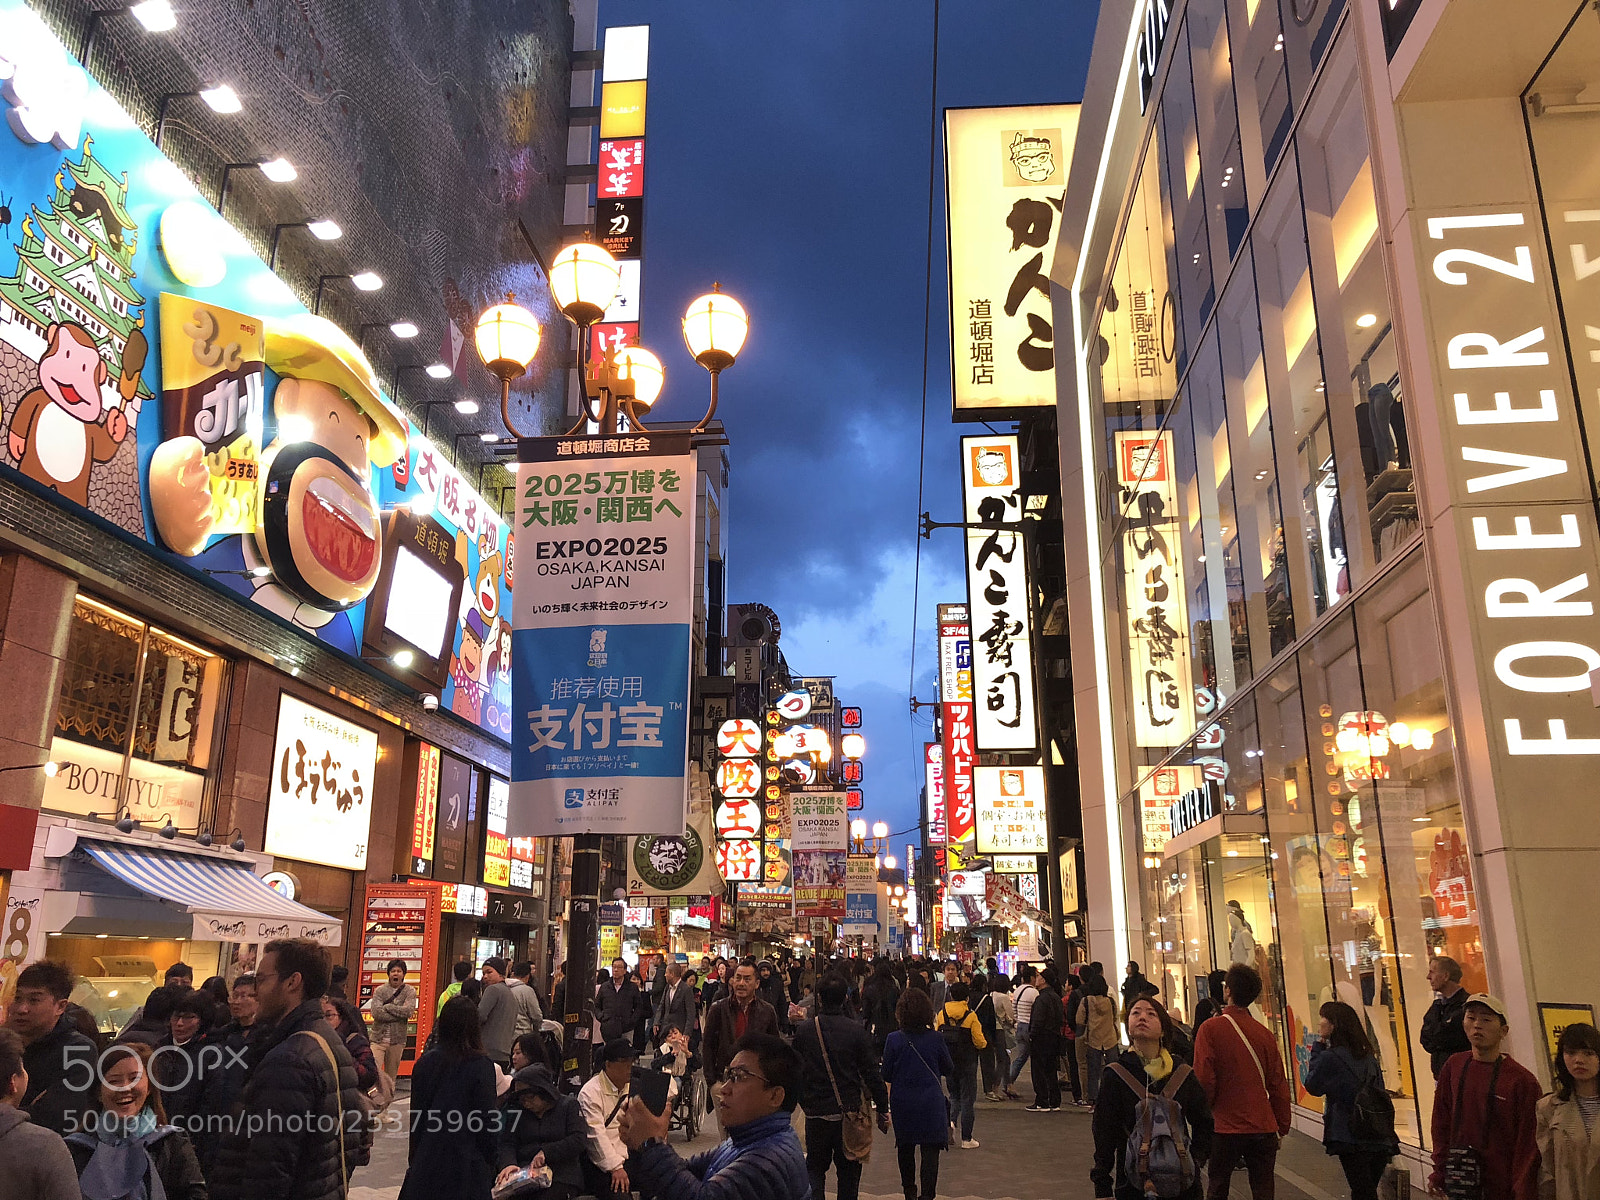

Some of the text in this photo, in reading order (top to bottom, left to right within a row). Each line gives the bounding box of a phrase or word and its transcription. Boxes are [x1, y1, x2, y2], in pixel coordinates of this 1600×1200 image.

[601, 142, 614, 152] 8F
[614, 203, 625, 211] 7F
[603, 236, 634, 244] MARKET
[239, 322, 256, 336] meiji
[968, 298, 995, 386] 道頓堀店
[193, 370, 265, 444] カール
[556, 436, 651, 456] 道頓堀商店会
[227, 460, 260, 481] うすあじ
[524, 468, 681, 498] 2025万博を
[1427, 212, 1600, 757] FOREVER 21
[418, 450, 498, 549] 大阪名物
[522, 495, 683, 529] 大阪・関西へ
[414, 520, 452, 566] 道頓堀
[536, 536, 668, 560] EXPO2025
[570, 575, 630, 591] JAPAN
[532, 599, 669, 615] いのち輝く未来社会のデザイン
[550, 675, 643, 701] 推荐使用
[946, 678, 954, 700] SHOP
[527, 700, 664, 753] 支付宝
[452, 766, 460, 781] 7F
[950, 705, 974, 826] ツルハドラッグ
[66, 762, 163, 809] BOTJYU
[280, 739, 364, 814] ぼてぢゅう
[586, 788, 620, 801] 支付宝
[717, 719, 760, 880] 大阪王将
[793, 796, 843, 806] 2025万博を
[1202, 780, 1213, 820] 21
[797, 819, 840, 827] EXPO2025
[355, 844, 366, 858] 2F
[416, 858, 426, 873] 3F
[640, 863, 668, 886] ZERO
[630, 880, 643, 890] 2F
[795, 889, 845, 900] REVUE JAPAN
[494, 900, 505, 915] 7F
[846, 908, 873, 919] 支付宝
[362, 987, 371, 995] 3F
